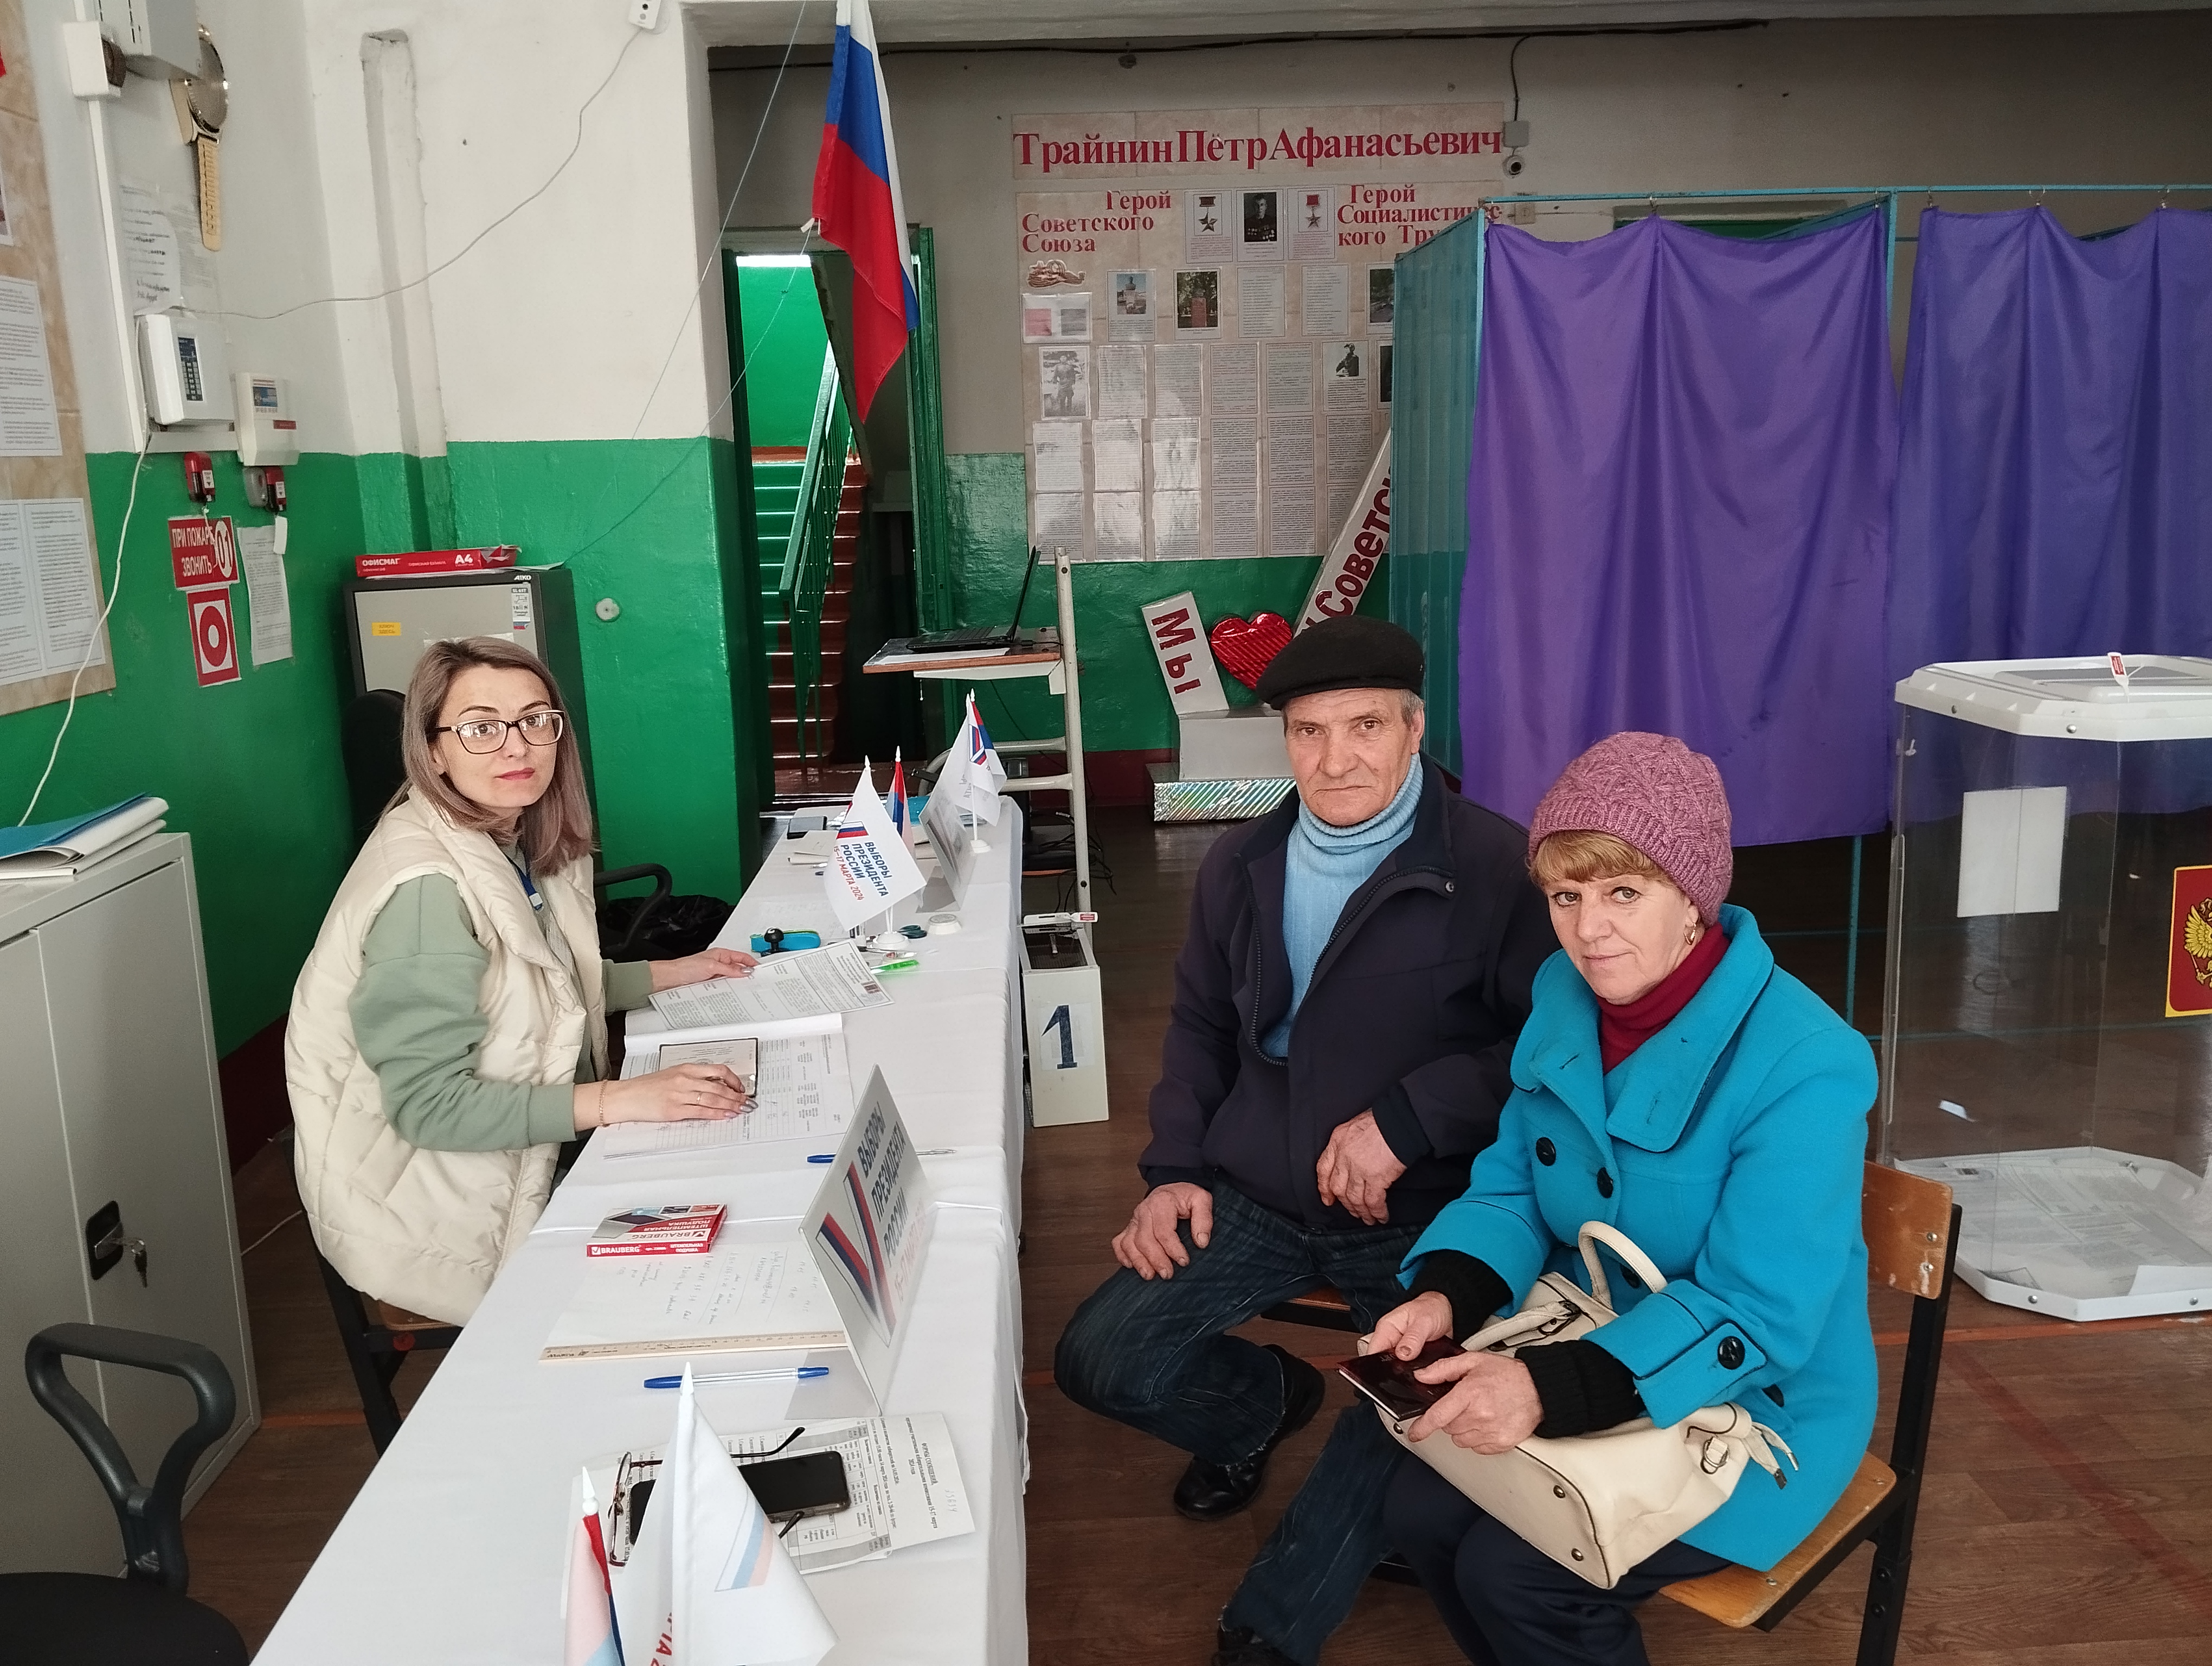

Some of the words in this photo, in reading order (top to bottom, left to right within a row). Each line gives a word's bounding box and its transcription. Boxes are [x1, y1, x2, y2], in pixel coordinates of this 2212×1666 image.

[1013, 133, 1173, 172] Трайнин
[1176, 130, 1268, 170] Пётр
[1269, 127, 1502, 167] Афанасьевич
[1106, 190, 1172, 215] Герой
[1351, 184, 1416, 208] Герой
[1021, 213, 1154, 233] Советского
[1337, 204, 1502, 225] Социалистис-
[1021, 233, 1096, 253] Союза
[1338, 230, 1386, 247] кого
[172, 528, 187, 548] ПРИ
[181, 555, 213, 577] ЗВОНИТЬ
[362, 558, 401, 567] ОФИСМАГ
[454, 554, 473, 563] A4
[840, 844, 866, 879] РОССИИ
[851, 843, 889, 896] ПРЕЗИДЕНТА
[864, 842, 893, 879] ВЫБОРЫ
[839, 864, 856, 885] МАРТА
[850, 886, 865, 900] 2024
[1041, 1004, 1078, 1069] 1
[857, 1100, 886, 1179] ВЫБОРЫ
[871, 1120, 906, 1223] ПРЕЗИДЕНТА
[883, 1187, 909, 1268] РОССИИ
[922, 1443, 930, 1457] ФОРМЫ
